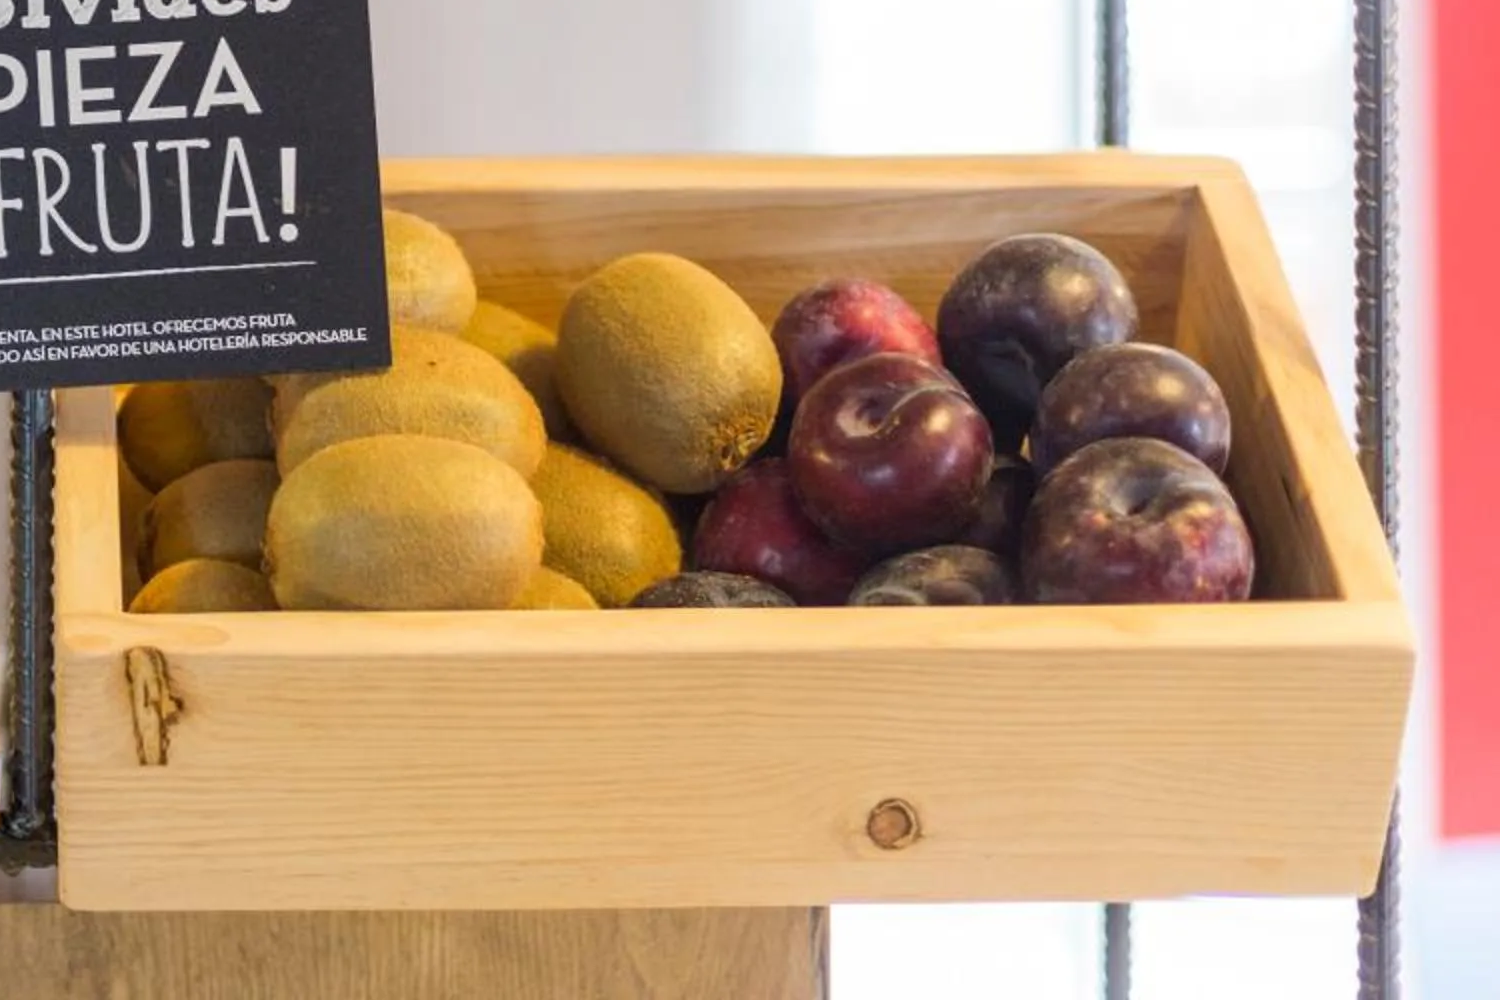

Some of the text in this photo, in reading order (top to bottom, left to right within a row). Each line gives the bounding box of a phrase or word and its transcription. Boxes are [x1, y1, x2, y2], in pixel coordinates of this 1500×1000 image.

[41, 327, 63, 342] EN
[64, 325, 100, 341] ESTE
[102, 322, 151, 338] HOTEL
[152, 315, 247, 335] OFRECEMOS
[249, 313, 297, 329] FRUTA
[22, 345, 46, 363] ASÍ
[47, 347, 69, 361] EN
[70, 343, 119, 360] FAVOR
[121, 341, 142, 357] DE
[143, 339, 177, 355] UNA
[179, 331, 261, 353] HOTELERÍA
[261, 327, 367, 348] RESPONSABLE
